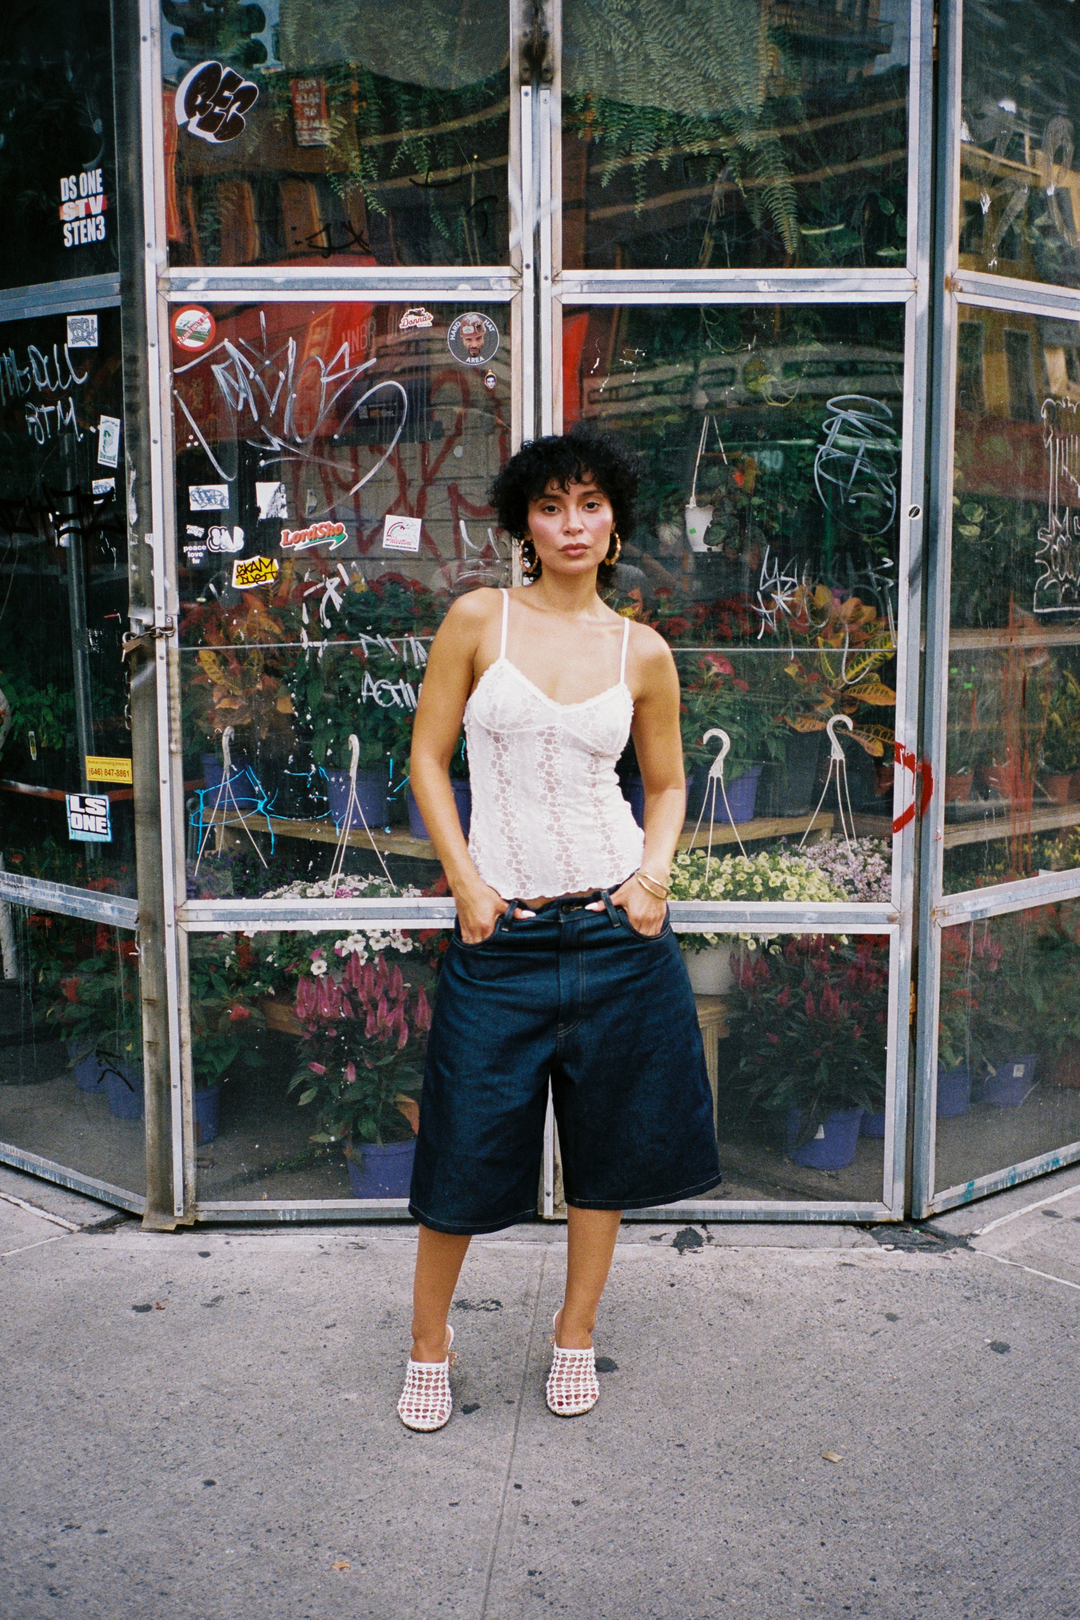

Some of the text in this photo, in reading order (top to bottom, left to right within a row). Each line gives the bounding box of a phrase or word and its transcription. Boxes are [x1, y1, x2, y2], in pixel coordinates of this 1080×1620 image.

[60, 168, 103, 202] DS ONE
[62, 194, 103, 222] STV
[63, 215, 105, 248] STEN3
[450, 319, 495, 341] HARD HAT
[281, 522, 344, 546] LordSko
[183, 545, 207, 553] peace
[236, 558, 274, 575] SKAM
[69, 795, 106, 817] LS
[70, 812, 107, 834] ONE
